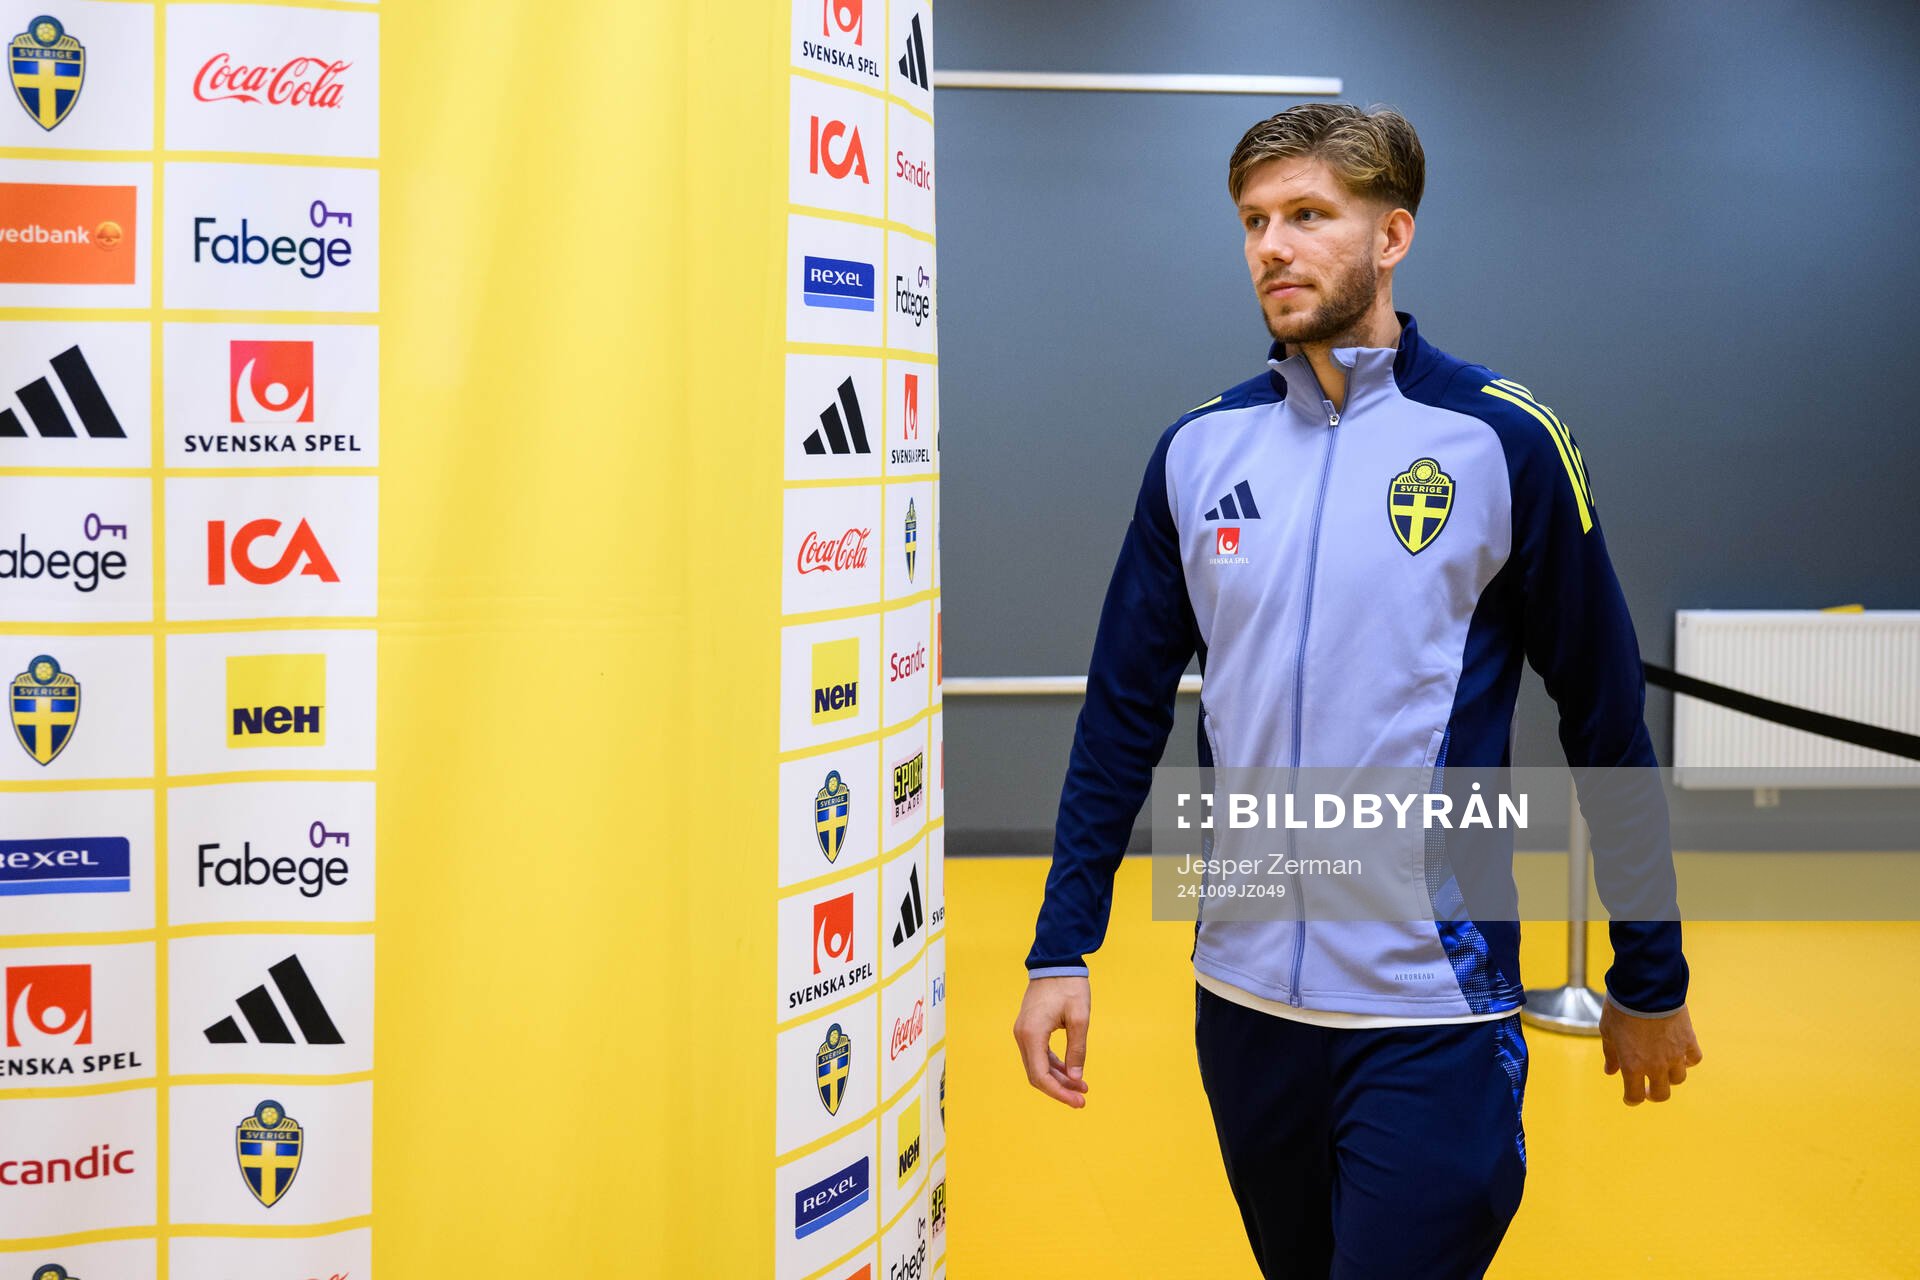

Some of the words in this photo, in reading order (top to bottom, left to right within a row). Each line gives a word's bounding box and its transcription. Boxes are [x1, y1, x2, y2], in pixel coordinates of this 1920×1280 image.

[19, 49, 73, 60] SVERIGE
[803, 41, 854, 69] SVENSKA
[858, 57, 879, 77] SPEL
[193, 53, 353, 109] Coca-Cola
[810, 115, 869, 184] ICA
[194, 217, 352, 279] Fabege
[185, 435, 296, 452] SVENSKA
[305, 435, 361, 452] SPEL
[1400, 485, 1443, 494] SVERIGE
[208, 517, 340, 585] ICA
[797, 528, 871, 574] Coca-Cola
[19, 687, 69, 697] SVERIGE
[820, 794, 845, 808] SVERIGE
[198, 842, 349, 898] Fabege
[789, 974, 845, 1008] SVENSKA
[849, 963, 872, 985] SPEL
[83, 1052, 142, 1074] SPEL
[821, 1046, 846, 1063] SVERIGE
[246, 1131, 293, 1141] SVERIGE
